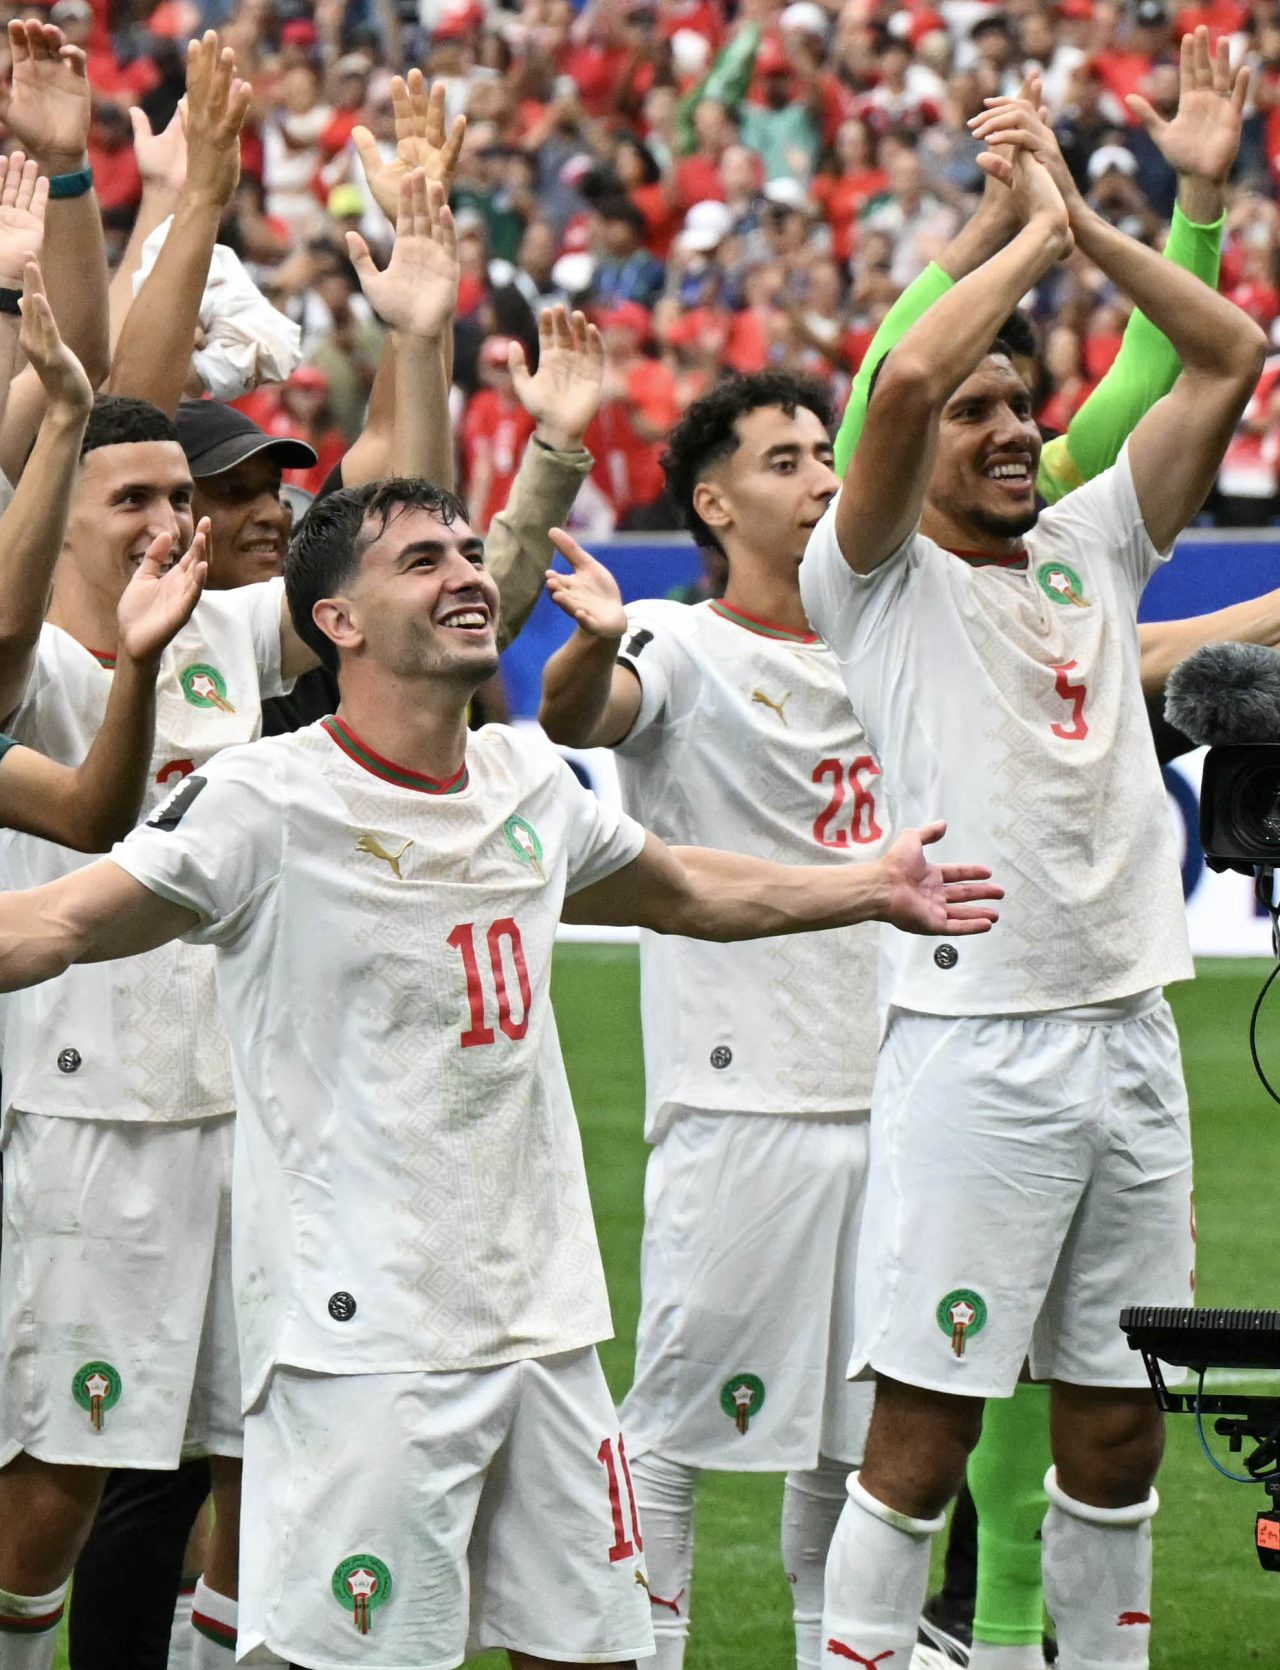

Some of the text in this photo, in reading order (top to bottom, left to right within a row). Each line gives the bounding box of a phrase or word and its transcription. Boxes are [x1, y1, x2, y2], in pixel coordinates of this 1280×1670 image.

[1050, 659, 1089, 741] 5
[812, 755, 883, 848] 26
[446, 917, 532, 1048] 10
